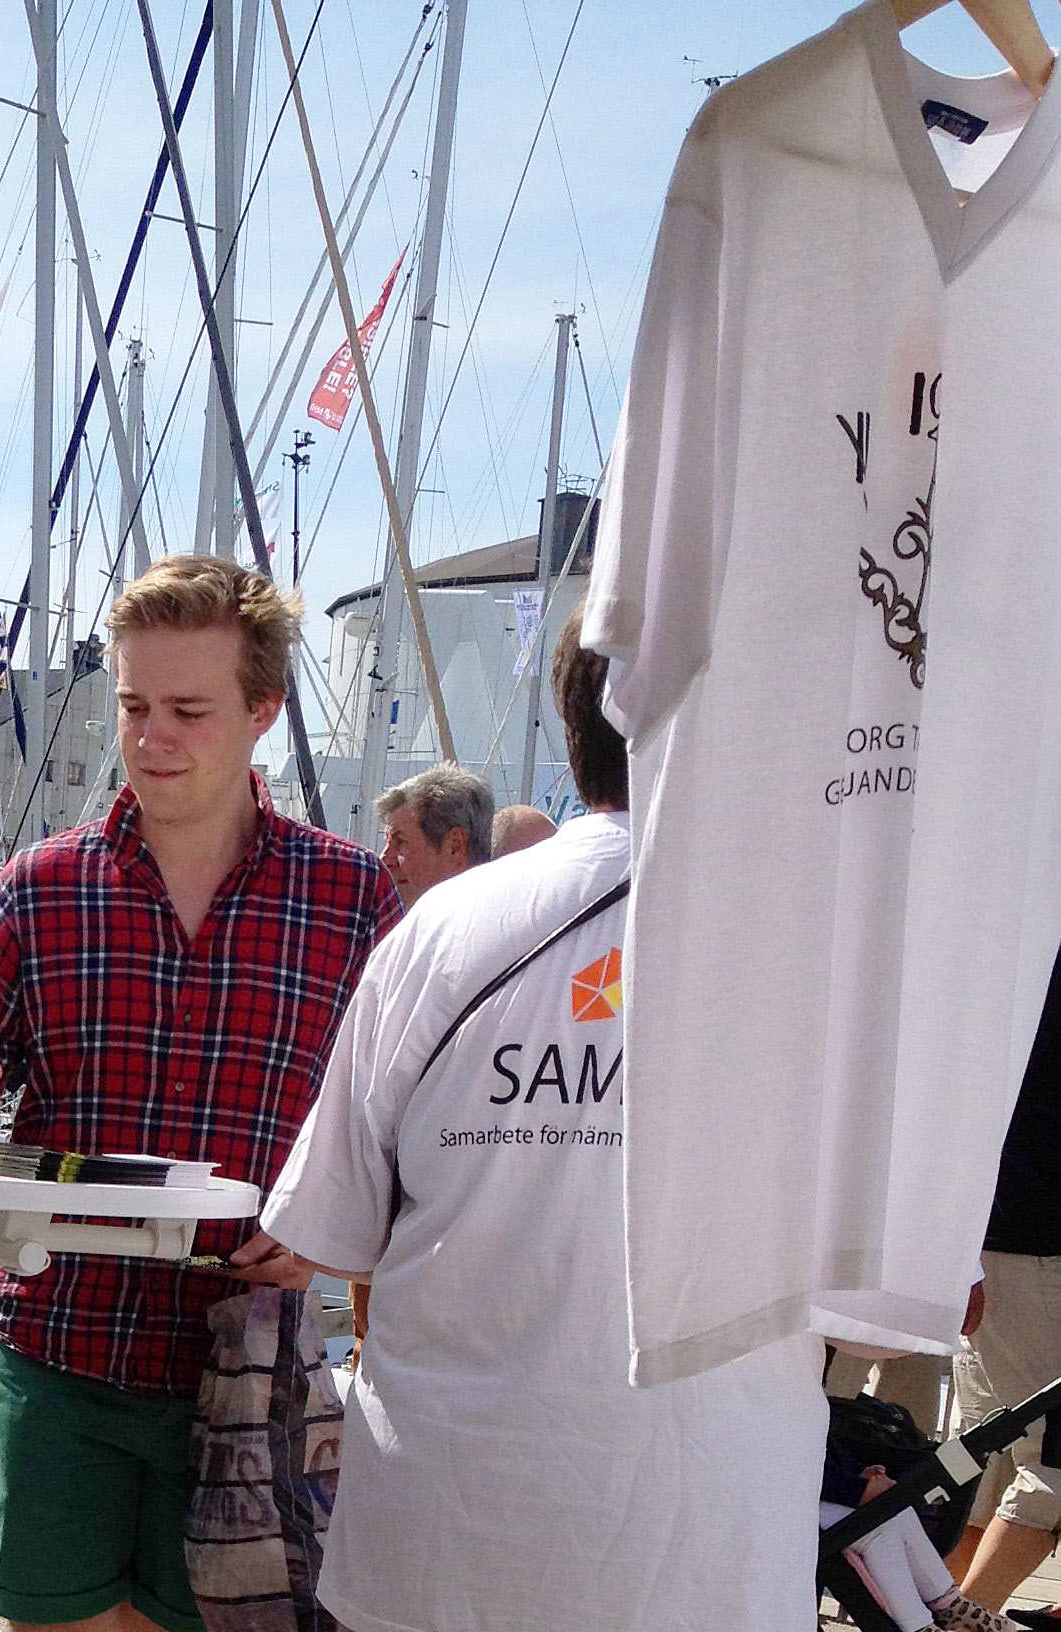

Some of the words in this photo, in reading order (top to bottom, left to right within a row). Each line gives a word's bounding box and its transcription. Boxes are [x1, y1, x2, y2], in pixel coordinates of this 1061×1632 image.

[846, 723, 905, 753] ORG
[439, 1124, 534, 1148] Samarbete
[540, 1124, 567, 1145] för
